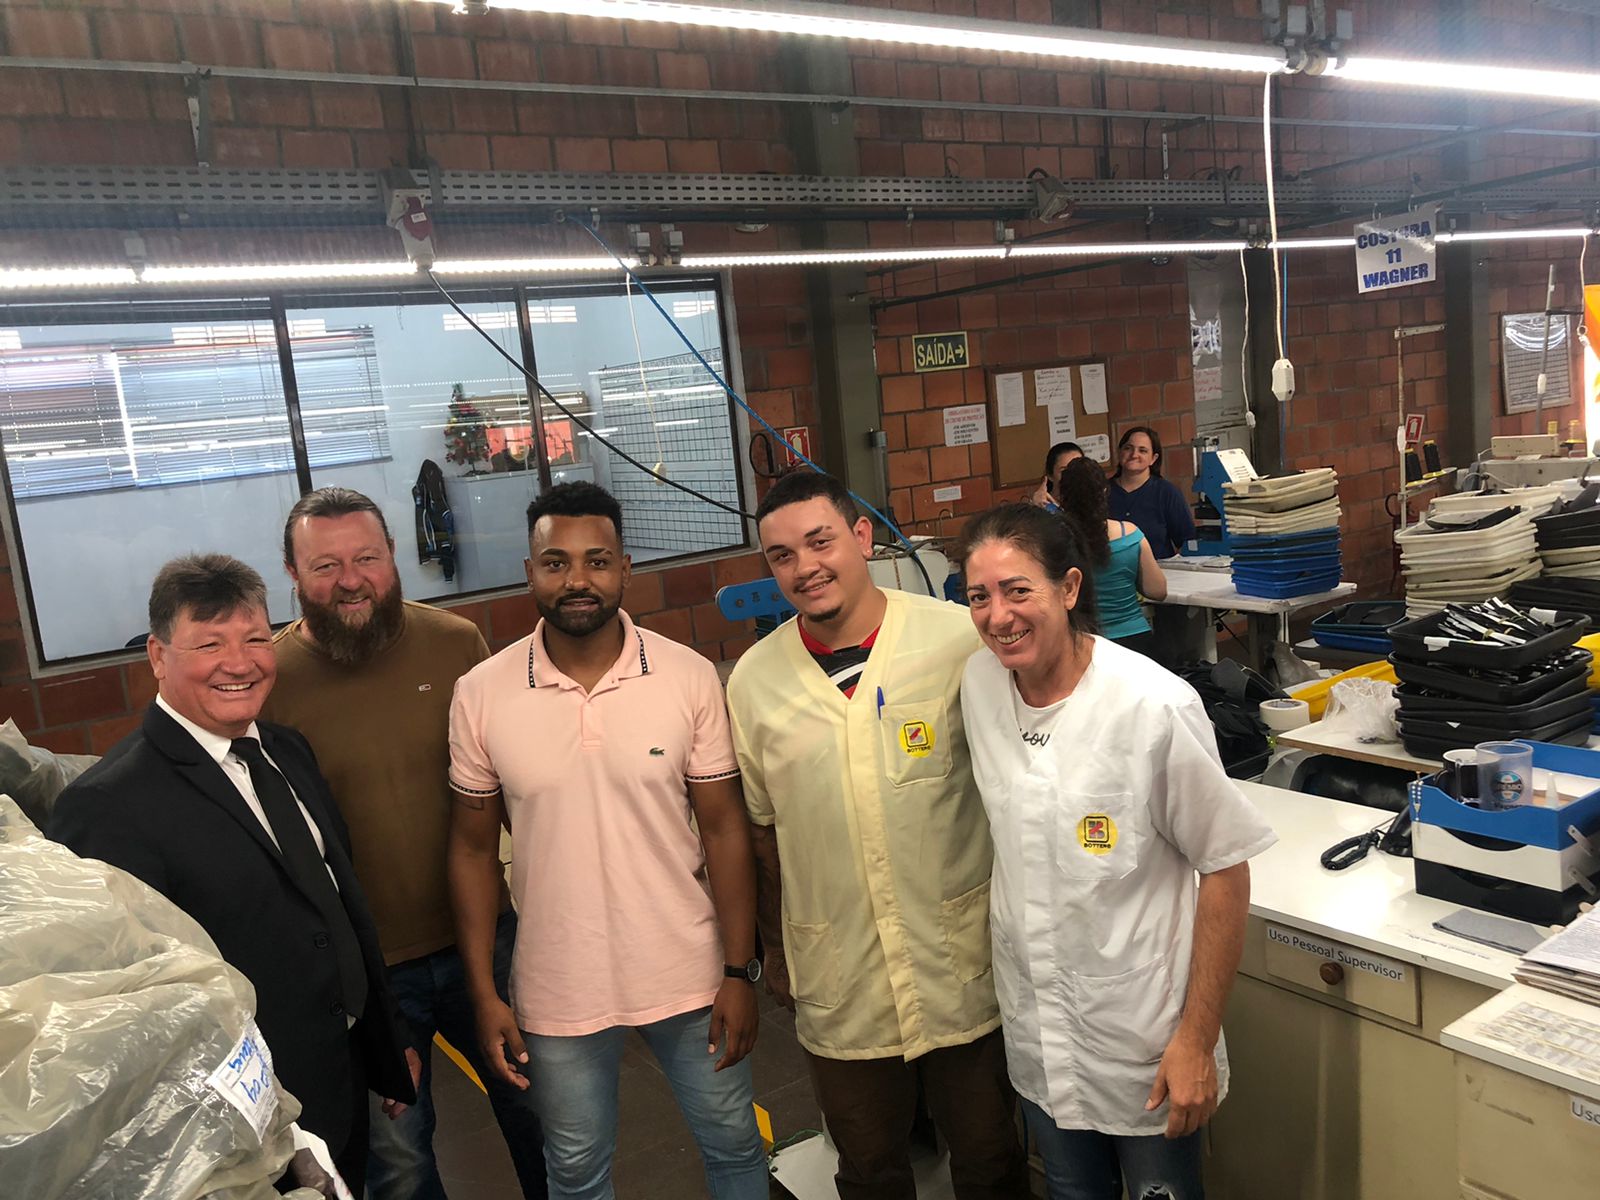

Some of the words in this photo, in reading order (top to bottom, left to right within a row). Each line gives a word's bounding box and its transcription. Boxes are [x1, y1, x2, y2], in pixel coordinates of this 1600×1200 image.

[1357, 221, 1431, 249] COSURA
[1385, 248, 1402, 264] 11
[1363, 263, 1429, 288] WAGNER
[917, 337, 955, 367] SAÍDA
[1269, 928, 1290, 945] Uso
[1292, 938, 1335, 959] Pessoal
[1337, 950, 1403, 980] Supervisor
